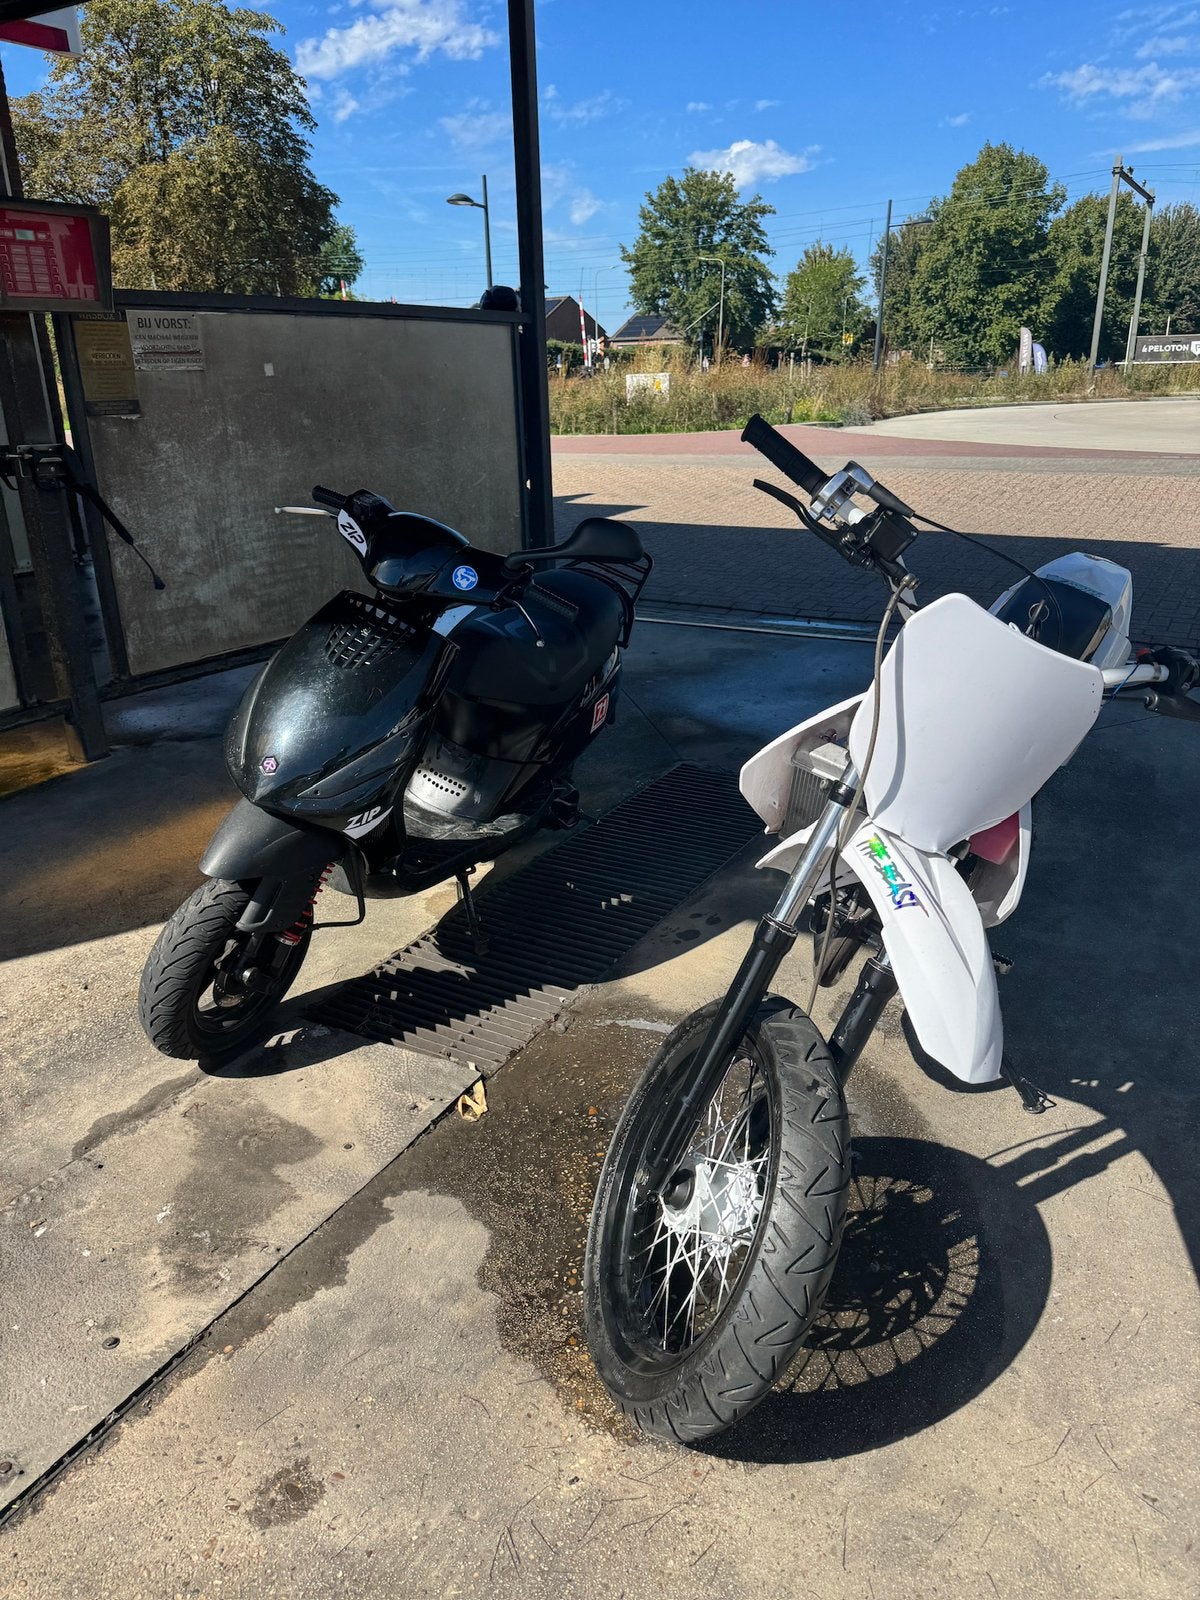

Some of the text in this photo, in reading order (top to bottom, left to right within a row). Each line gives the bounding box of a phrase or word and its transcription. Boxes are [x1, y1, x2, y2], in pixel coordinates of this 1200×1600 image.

[137, 317, 192, 329] BIJ VORST:
[1148, 344, 1190, 352] PELOTON
[340, 521, 365, 544] ZIP
[344, 806, 382, 830] ZIP
